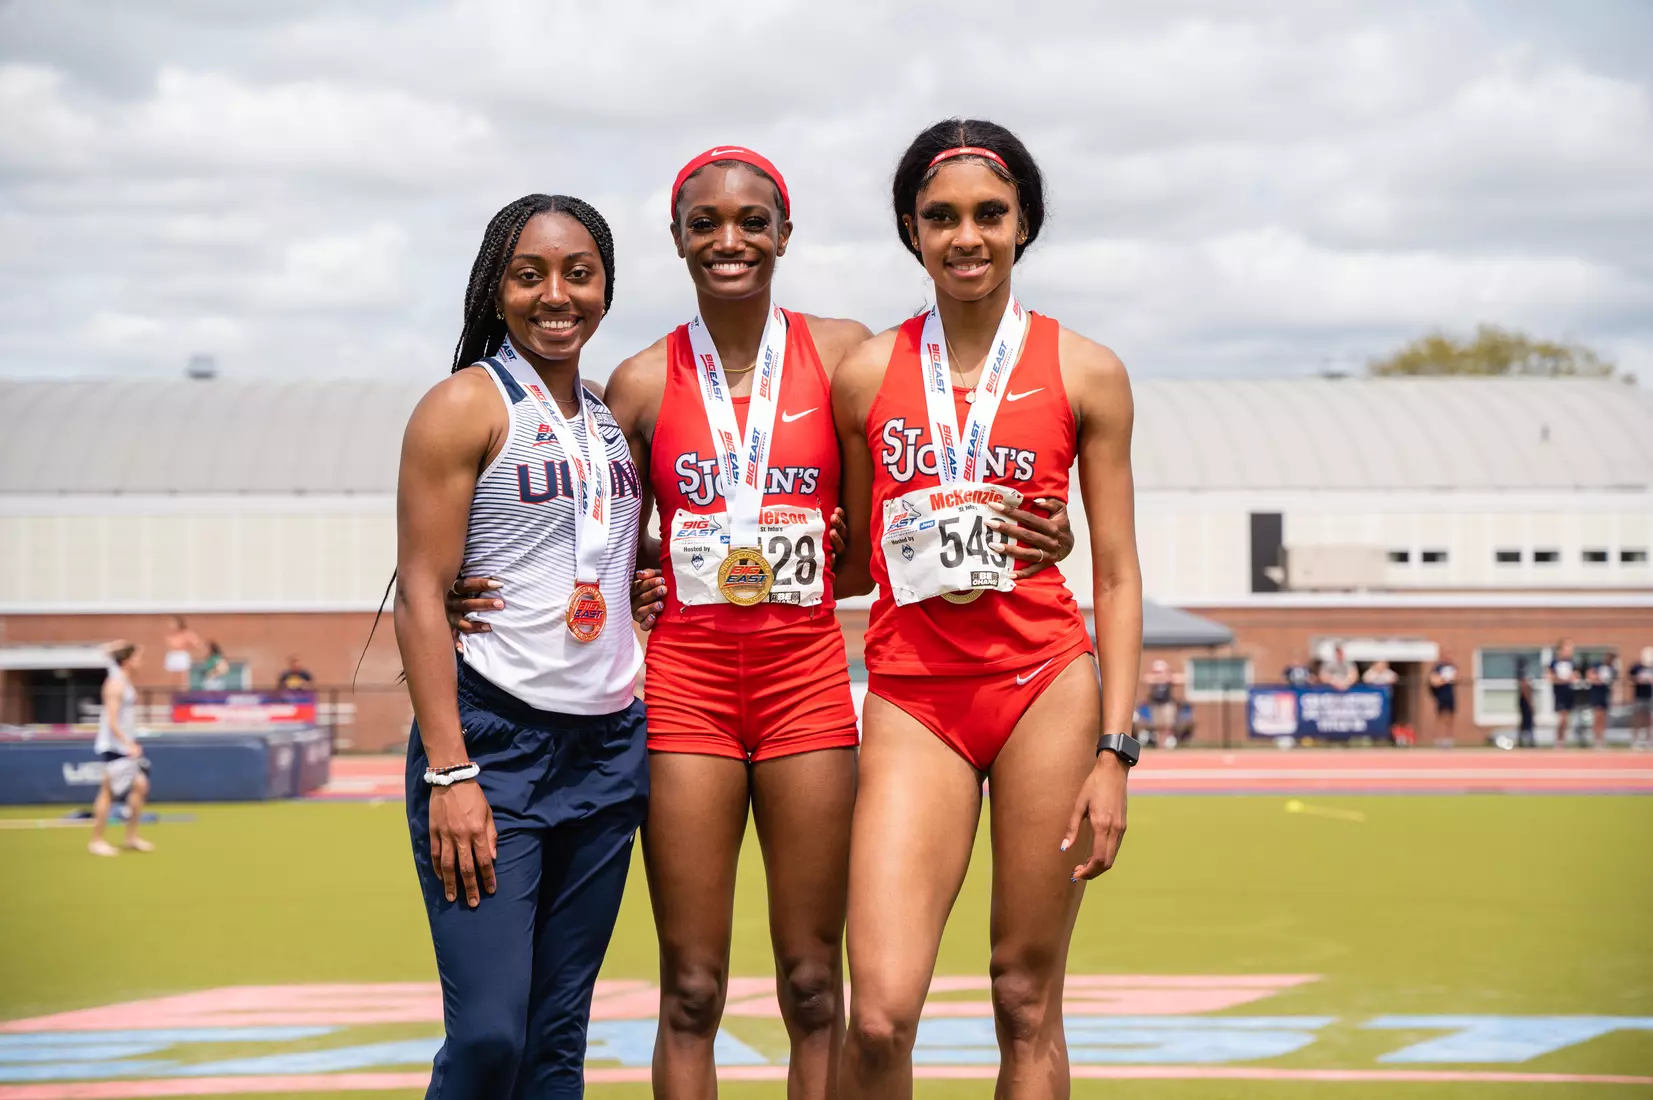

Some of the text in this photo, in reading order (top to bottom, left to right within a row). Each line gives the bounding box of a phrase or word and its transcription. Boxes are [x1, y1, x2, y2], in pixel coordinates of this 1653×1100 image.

[705, 354, 716, 372] BIG
[759, 345, 773, 398] BIG EAST
[932, 343, 947, 395] BIG EAST
[985, 340, 1008, 394] BIG EAST
[710, 372, 724, 402] EAST
[530, 384, 566, 429] BIG EAST
[535, 433, 558, 441] EA
[724, 431, 736, 453] BIG
[943, 424, 954, 448] BIG
[745, 427, 761, 487] BIG EAST
[882, 417, 1036, 483] ST JON'S
[963, 420, 981, 482] BIG EAST
[575, 457, 586, 481] BIG
[674, 451, 718, 495] ST
[688, 466, 821, 506] JN'S
[592, 496, 602, 520] BIG
[929, 489, 1004, 511] McKenzie
[682, 520, 709, 529] BIG
[758, 511, 808, 525] erson
[676, 528, 719, 537] EAST
[731, 565, 760, 575] BIG
[757, 535, 818, 586] 28
[725, 574, 768, 583] EAST
[574, 610, 604, 618] EAST
[577, 600, 600, 610] BIG
